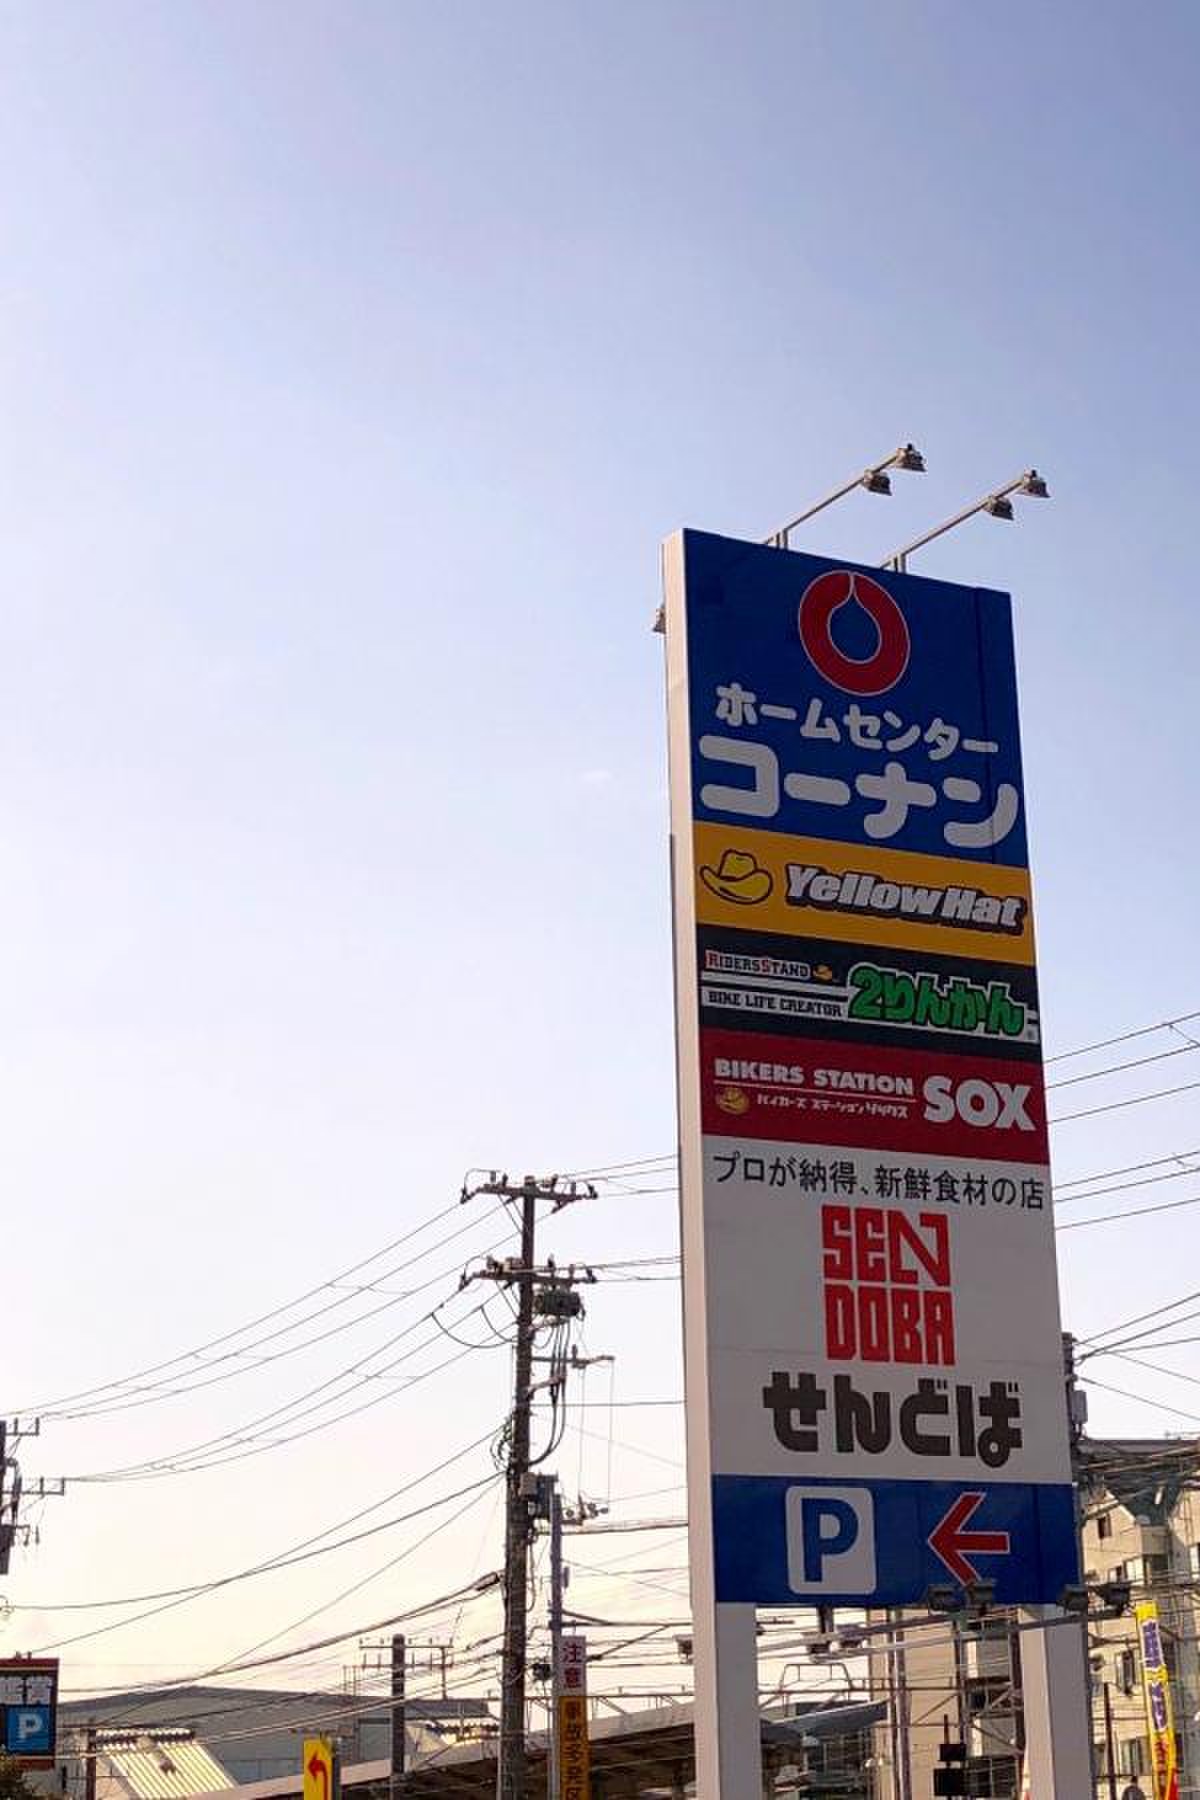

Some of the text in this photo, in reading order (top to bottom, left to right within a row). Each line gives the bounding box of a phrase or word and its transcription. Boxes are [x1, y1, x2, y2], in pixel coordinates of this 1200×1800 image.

[716, 684, 998, 759] ホームセンター
[699, 735, 1019, 848] コーナン
[708, 991, 843, 1018] BIKE LIFE CREATOR
[848, 962, 1028, 1037] 2りんかん
[714, 1057, 1037, 1132] BIKERS STATION SOX
[713, 1152, 1044, 1209] プロが納得、新鮮食材の店
[822, 1204, 951, 1287] SEN
[824, 1283, 957, 1366] DOBA
[762, 1371, 1024, 1469] せんどば
[801, 1497, 860, 1583] P
[563, 1641, 582, 1689] 注意
[19, 1714, 42, 1738] P
